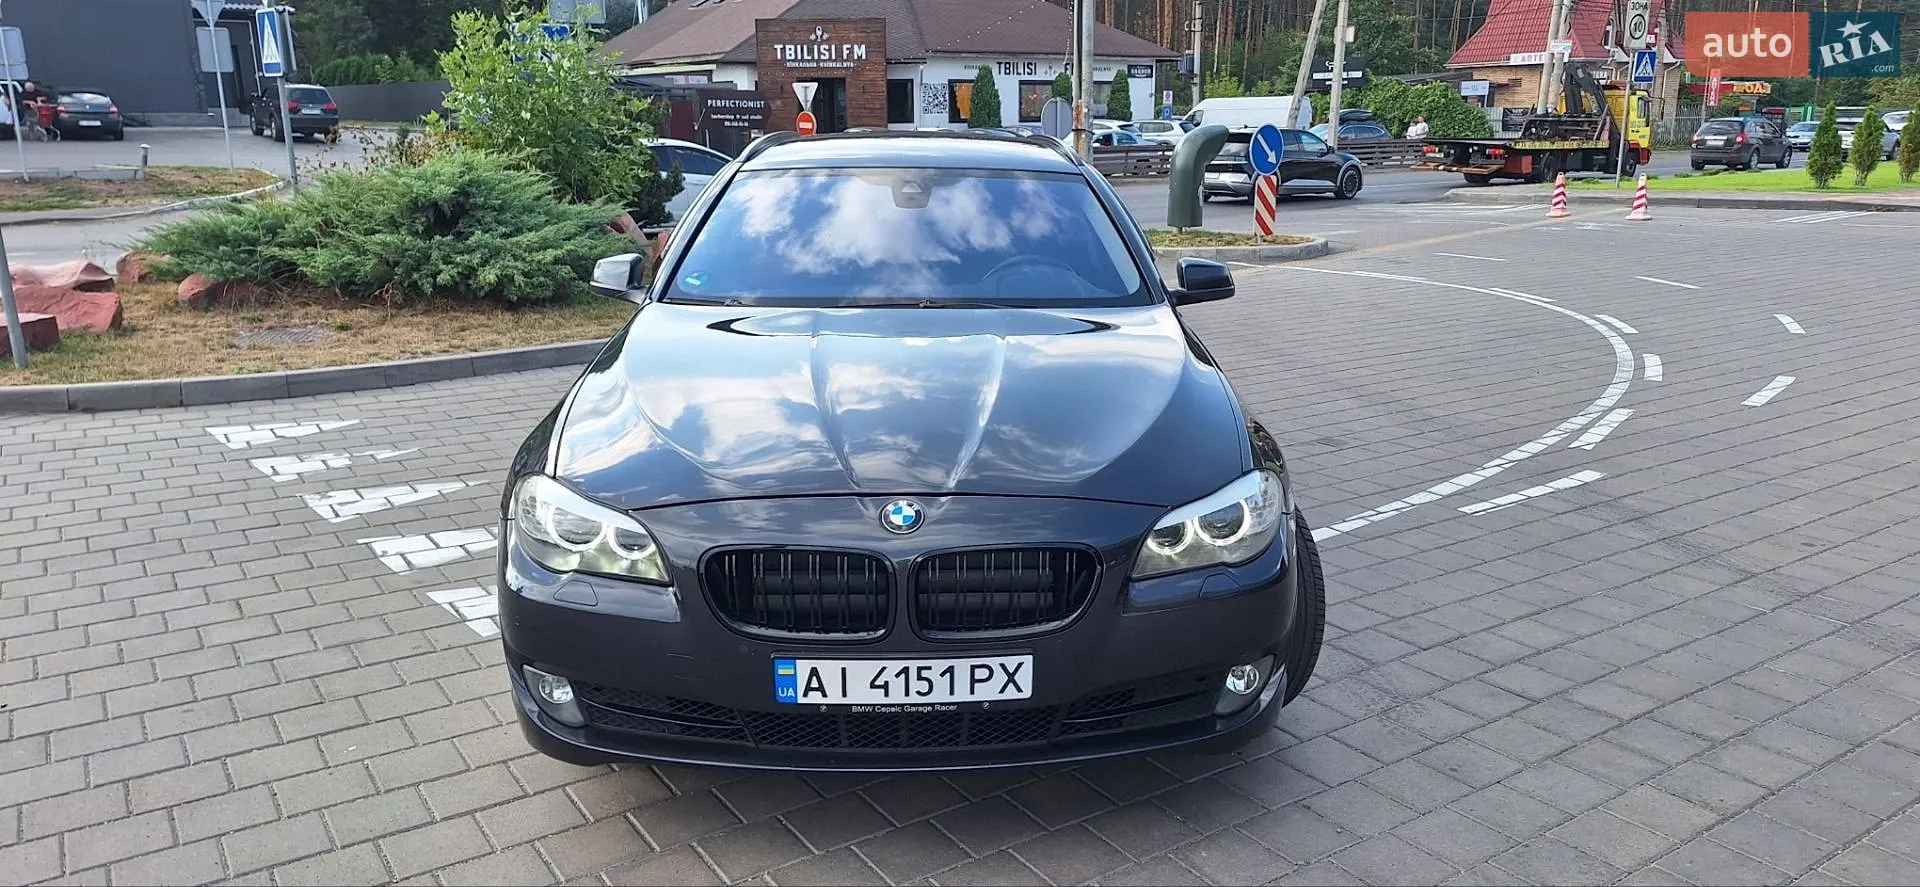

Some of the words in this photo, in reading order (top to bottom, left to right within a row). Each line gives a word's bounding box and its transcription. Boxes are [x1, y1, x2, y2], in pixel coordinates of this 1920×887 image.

[1631, 1, 1648, 11] ЗОНА
[1633, 21, 1643, 33] 10
[774, 44, 836, 60] TBILISI
[842, 44, 867, 60] FM
[996, 61, 1037, 76] TBILISI
[707, 99, 765, 108] PERFECTIONIST
[802, 666, 848, 698] AI
[869, 665, 955, 697] 4151
[969, 661, 1025, 696] PX
[778, 687, 795, 697] UA
[851, 705, 873, 713] BMW
[903, 705, 933, 714] Garage
